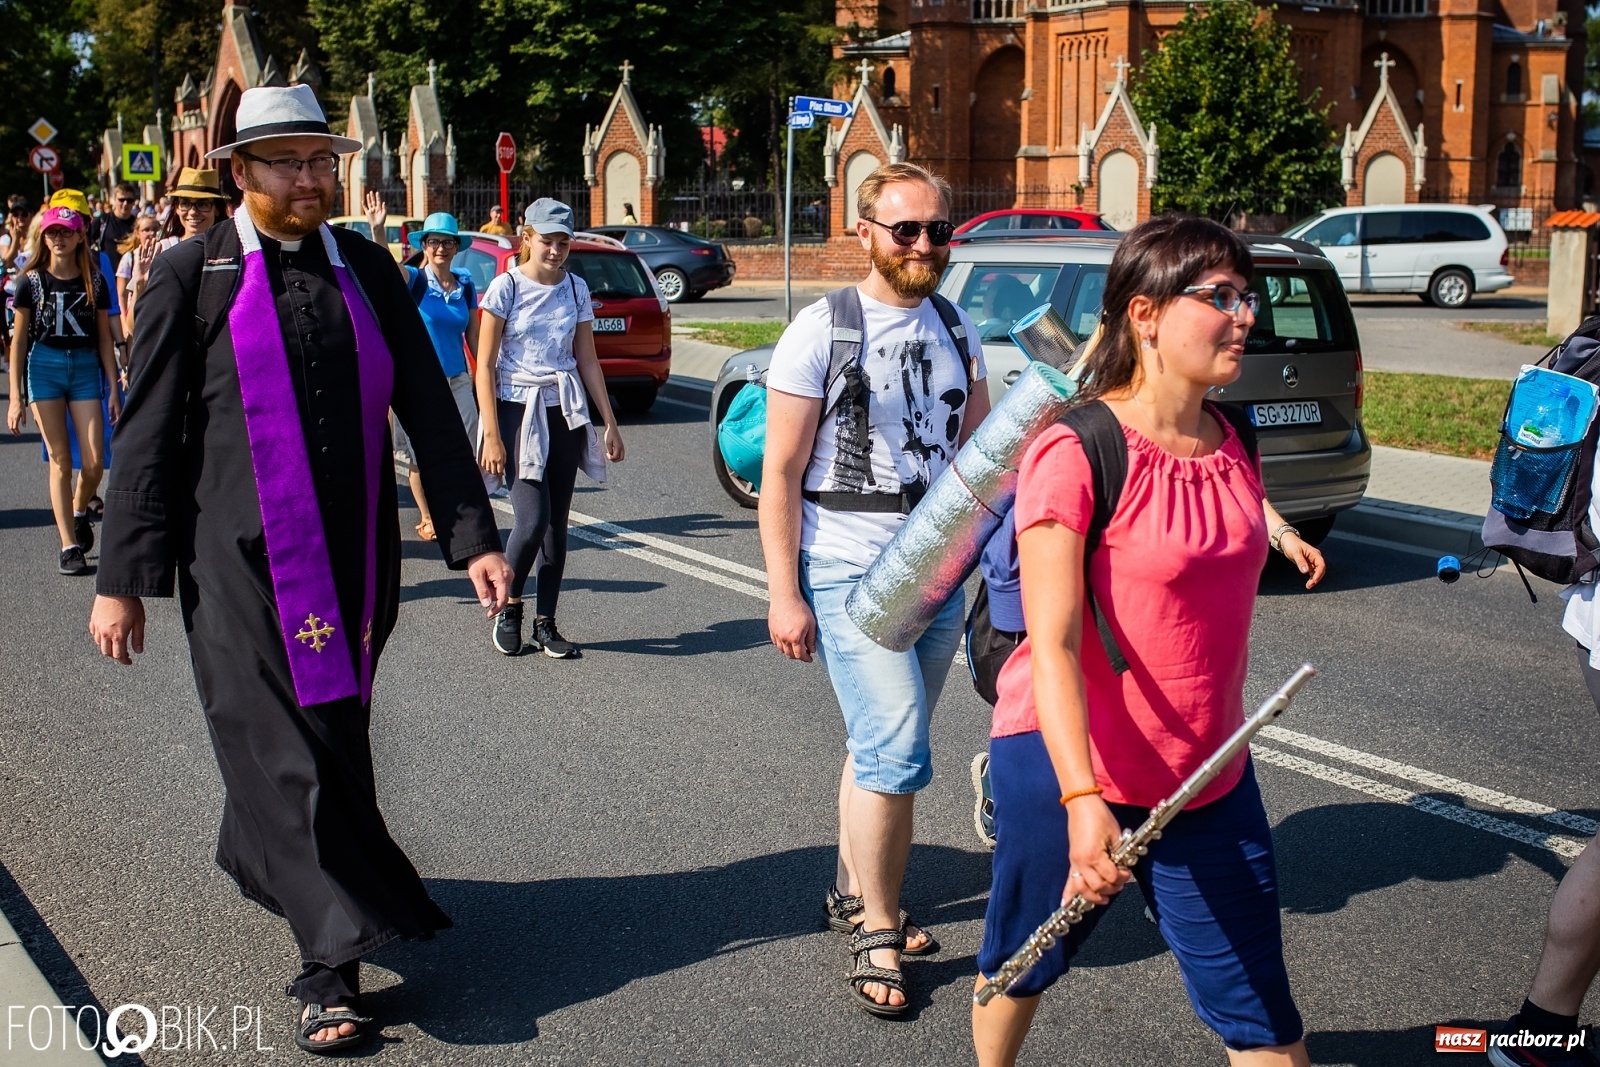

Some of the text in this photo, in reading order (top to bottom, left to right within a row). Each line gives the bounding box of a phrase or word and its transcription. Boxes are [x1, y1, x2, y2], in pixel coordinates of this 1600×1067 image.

[499, 147, 514, 159] STOP
[597, 319, 623, 331] AG68
[1256, 403, 1320, 424] SG 3270R
